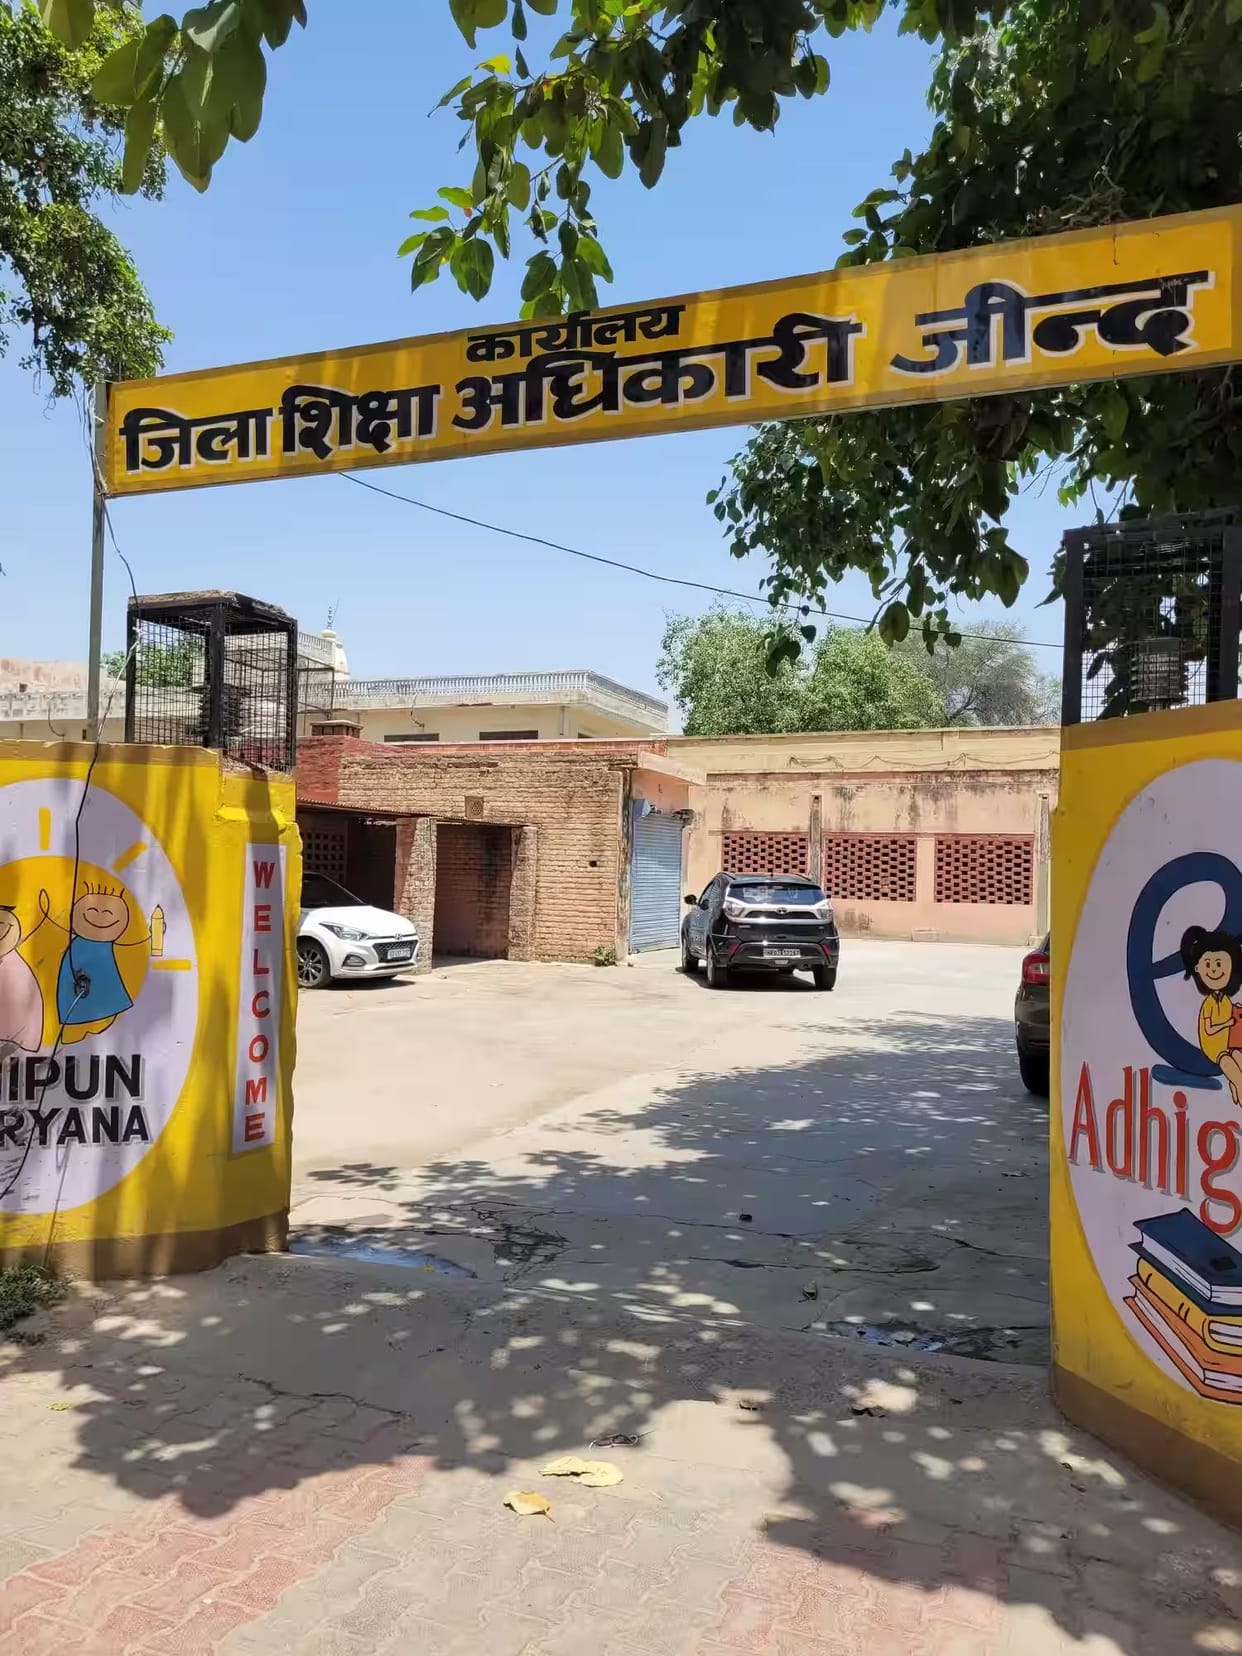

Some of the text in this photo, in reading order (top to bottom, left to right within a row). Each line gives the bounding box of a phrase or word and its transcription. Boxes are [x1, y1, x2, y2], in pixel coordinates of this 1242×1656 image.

[119, 270, 1212, 473] जिला शिक्षा अधिकारी जीन्द
[466, 305, 686, 362] कार्यालय
[244, 860, 276, 1142] WELCOME
[0, 1054, 142, 1101] IPUN
